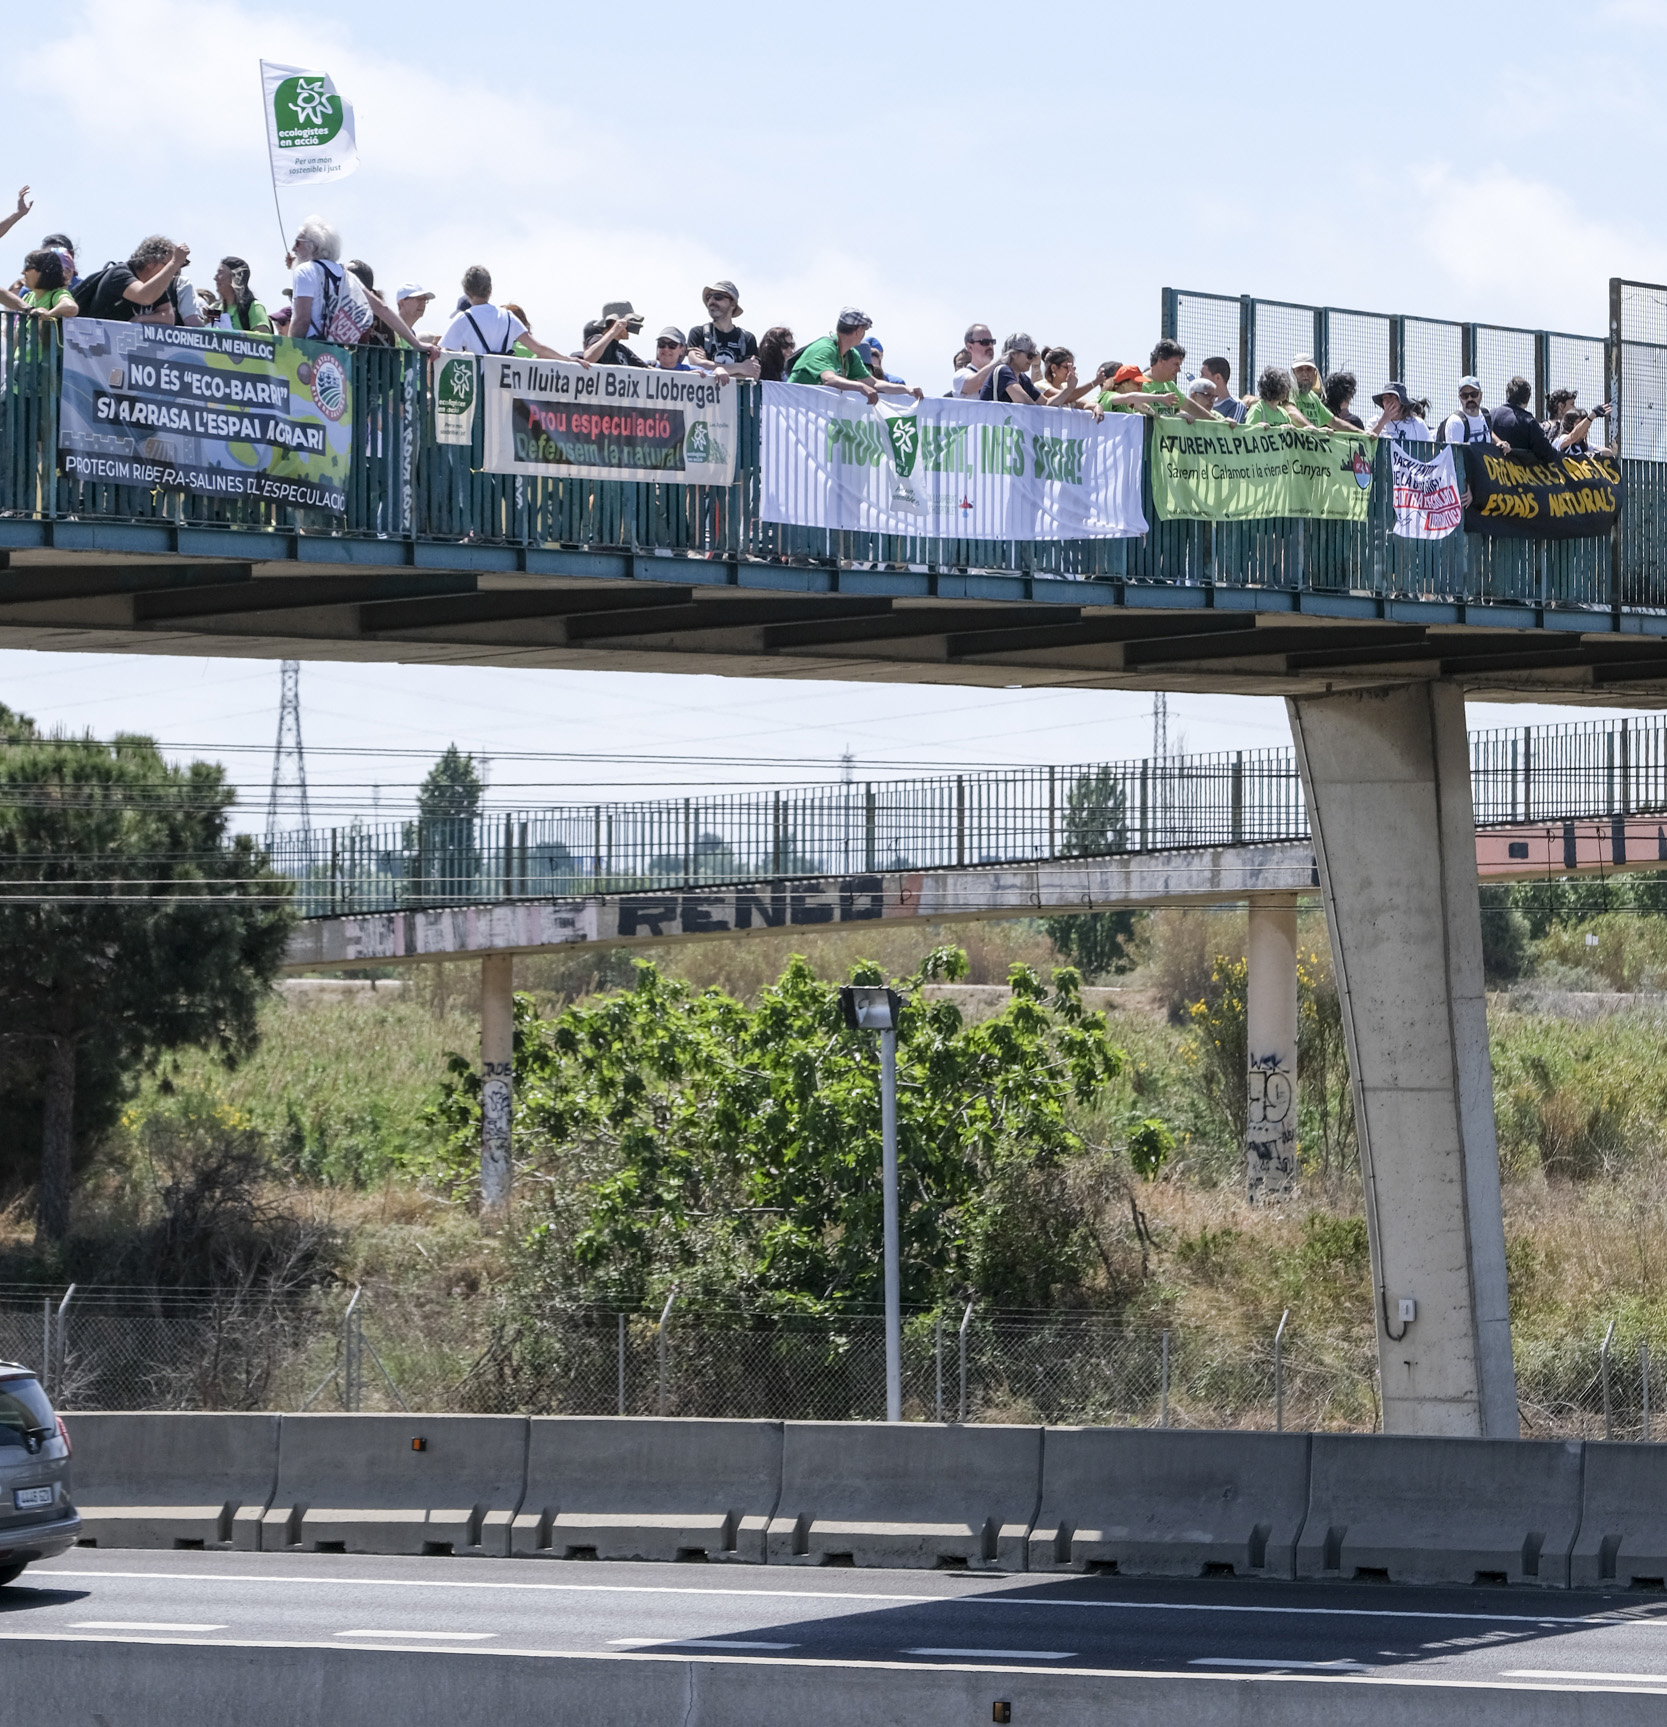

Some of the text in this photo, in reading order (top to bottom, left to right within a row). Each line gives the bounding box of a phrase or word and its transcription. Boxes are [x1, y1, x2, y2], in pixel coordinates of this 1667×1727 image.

[279, 128, 329, 139] ecologistes
[280, 136, 319, 147] en acció
[144, 325, 155, 341] NI
[156, 327, 165, 342] A
[165, 328, 221, 352] CORNELLÀ,
[222, 338, 233, 353] NI
[130, 363, 156, 388] NO
[160, 363, 181, 392] ÉS
[499, 363, 721, 410] En lluita pel Baix Llobregat
[118, 400, 192, 432] ARRASA
[194, 411, 261, 439] L'ESPAI
[266, 419, 324, 450] AGRARI
[528, 404, 671, 441] Prou especulació
[516, 432, 600, 463] Defensem
[603, 438, 620, 465] la
[827, 417, 886, 468] PROU
[981, 415, 1026, 477] MÉS
[1032, 433, 1085, 486] VIDA!
[1159, 434, 1217, 455] ATUREM
[1217, 436, 1234, 455] EL
[1233, 435, 1260, 455] PLA
[1260, 434, 1280, 454] DE
[65, 456, 130, 479] PROTEGIM
[133, 463, 244, 493] RIBERA-SALINES
[1201, 464, 1209, 480] el
[1211, 463, 1251, 480] Calamot
[1292, 459, 1332, 481] Canyars
[1548, 486, 1615, 518] NATURALS
